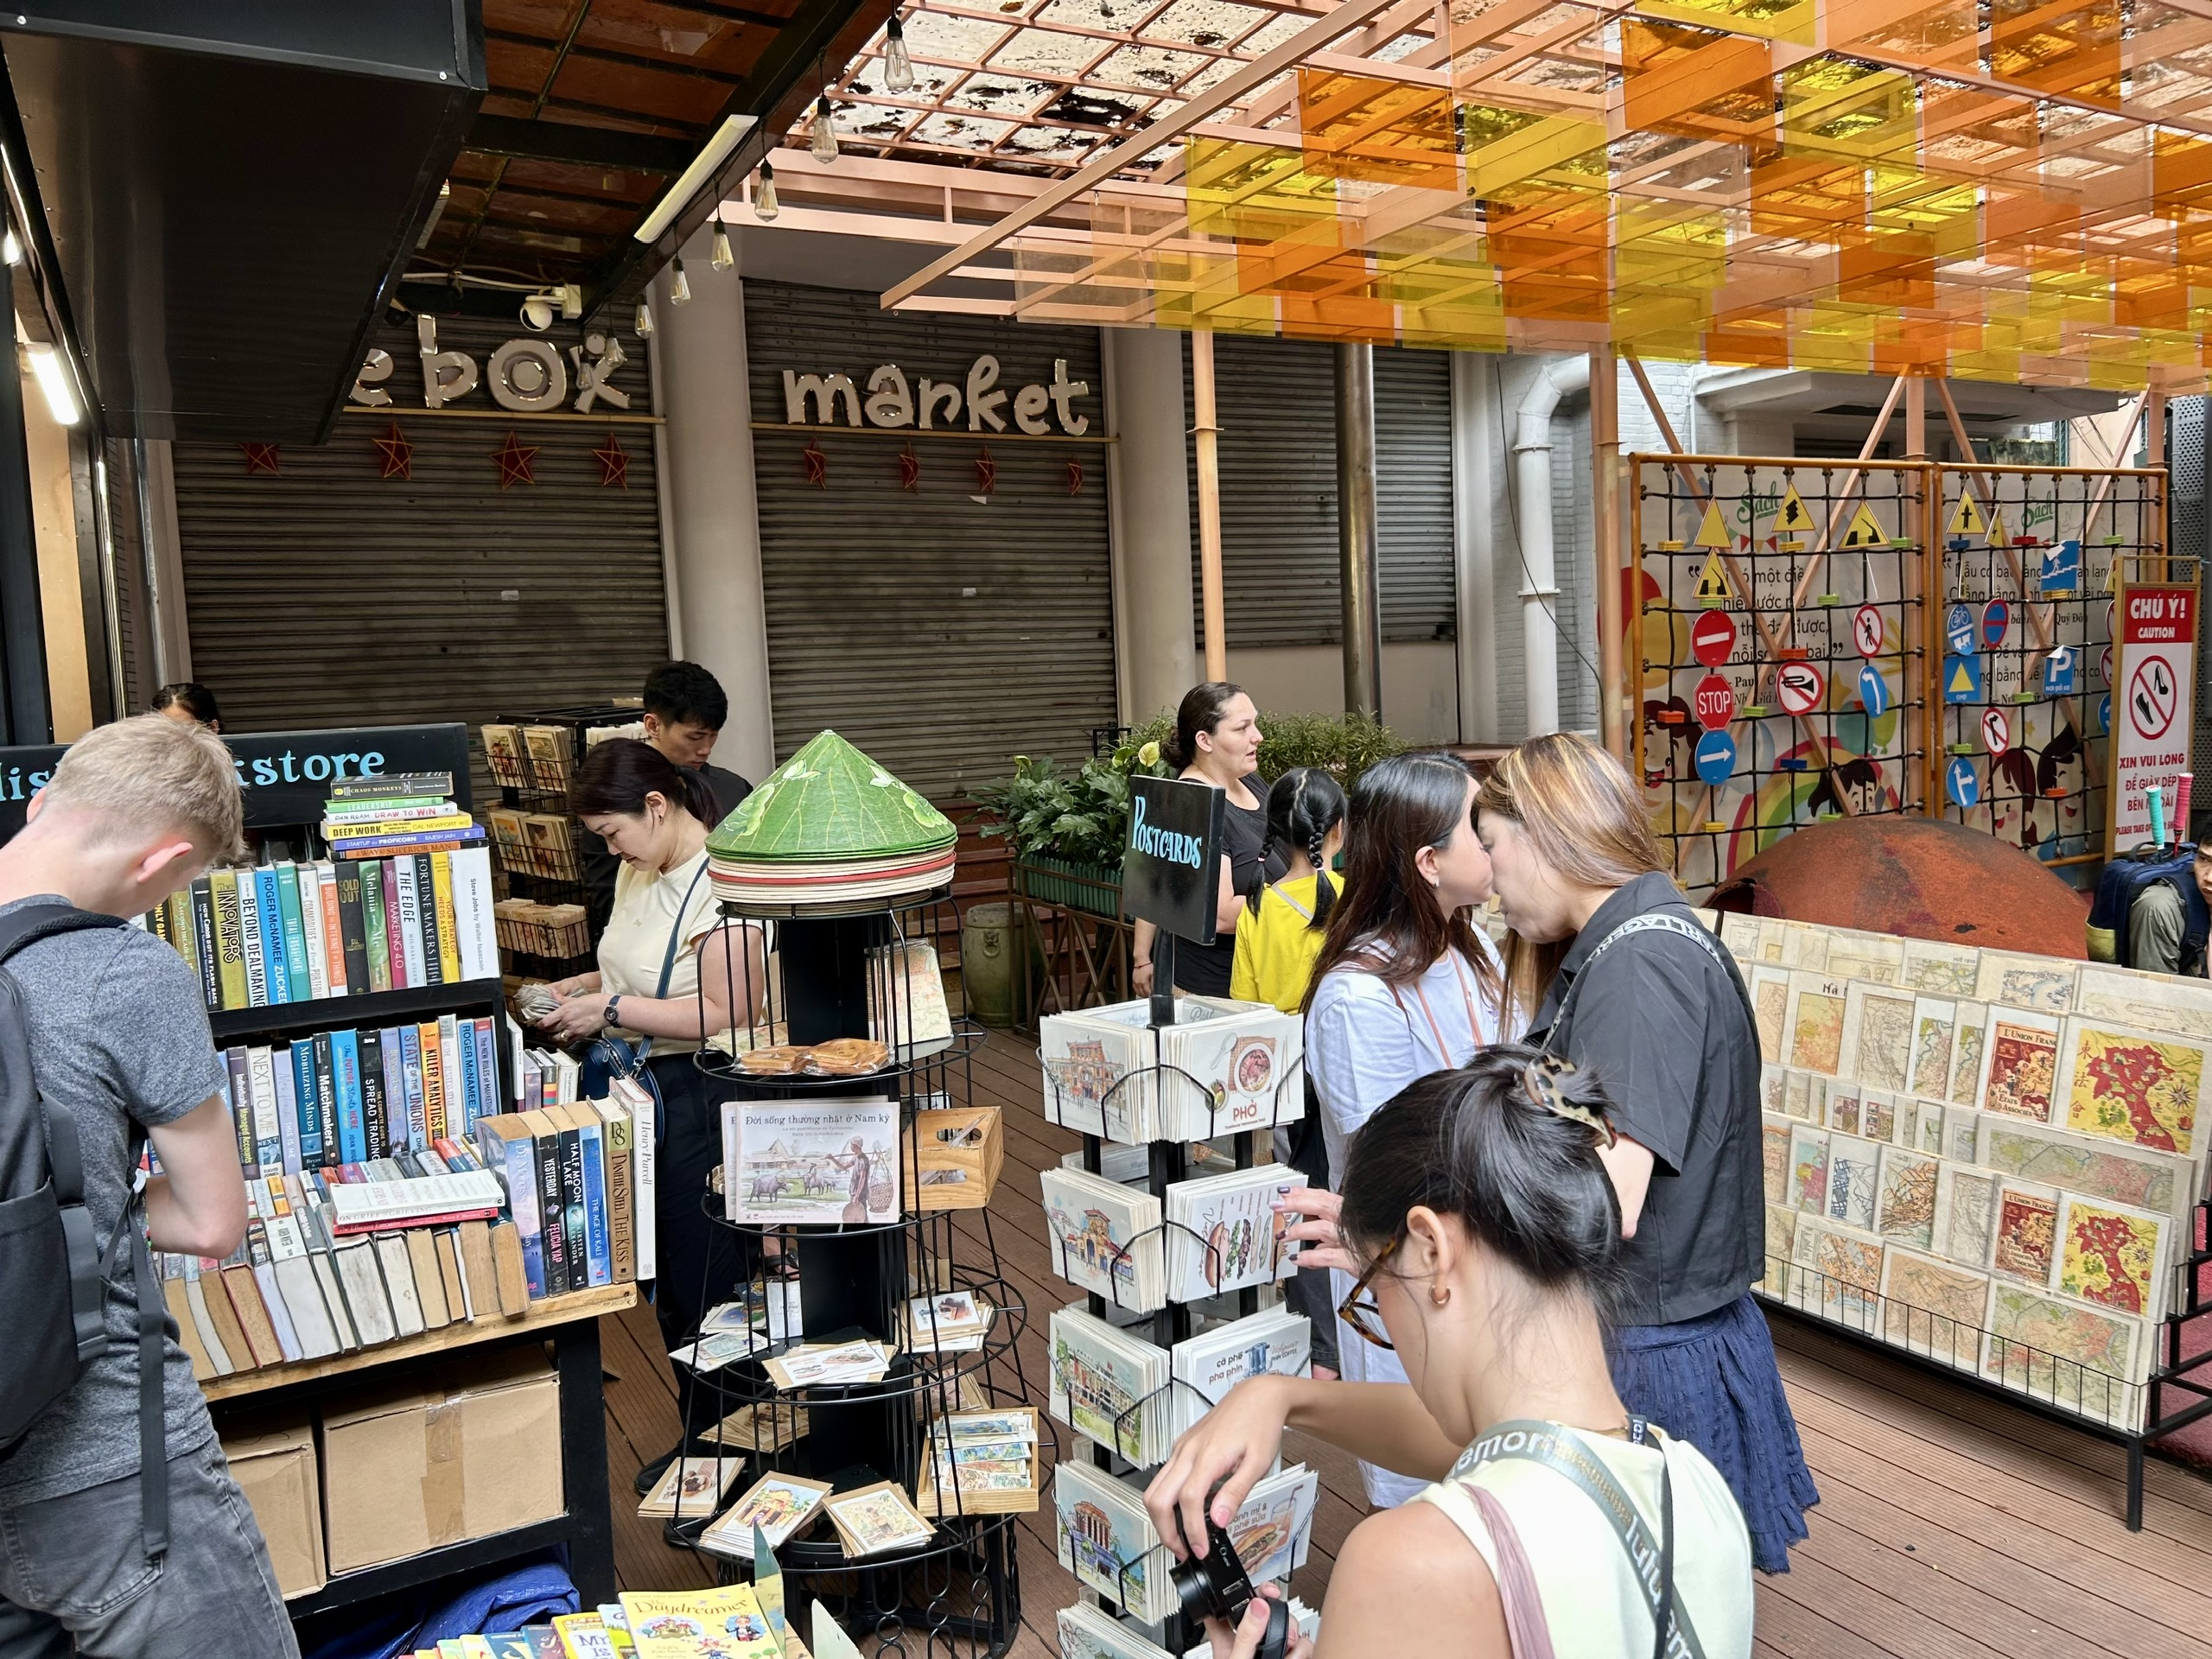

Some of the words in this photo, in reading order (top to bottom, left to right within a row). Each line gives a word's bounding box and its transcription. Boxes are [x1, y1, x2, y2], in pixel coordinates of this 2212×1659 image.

[782, 353, 1090, 436] market
[2130, 593, 2164, 619] CHÚ
[2168, 594, 2186, 619] Ý!
[2138, 626, 2176, 639] CAUTION
[1735, 676, 1757, 688] Pau
[1698, 690, 1731, 715] STOP
[2119, 756, 2137, 770] XIN
[2139, 754, 2157, 767] VUI
[2126, 772, 2138, 791] ĐỂ
[2162, 773, 2177, 787] DÉP
[347, 801, 392, 811] LEADERSHIP
[374, 810, 399, 819] DRAW
[2127, 796, 2143, 811] BÊN
[333, 827, 353, 837] DEEP
[355, 825, 382, 836] WORK
[427, 820, 457, 829] NEWPORT
[378, 836, 416, 845] PROFICORN
[1131, 795, 1202, 870] POSTCARDS
[387, 843, 428, 855] SUPERIOR
[431, 842, 452, 851] MAN
[264, 876, 277, 912] ROGER
[339, 879, 359, 892] SOLD
[399, 871, 412, 891] THE
[418, 858, 432, 908] FORTUNE
[325, 887, 336, 916] BUILDING
[340, 891, 359, 904] OUT
[366, 872, 378, 912] Melania
[372, 930, 383, 948] Me
[402, 896, 415, 923] EDGE
[446, 900, 454, 919] YOUR
[203, 918, 212, 939] Canon
[217, 889, 243, 963] INNOVATORS
[243, 898, 259, 940] BEYOND
[389, 901, 403, 950] MARKETING
[268, 913, 283, 963] McNAMEE
[329, 924, 340, 954] INTERNET
[423, 912, 436, 955] MAKERS
[441, 926, 449, 959] STRATEGY
[448, 920, 456, 954] STRATEGY
[476, 944, 485, 972] Isaacson
[248, 944, 265, 1007] DEALMAKING
[333, 961, 342, 983] THINGS
[404, 1034, 419, 1070] STATE
[462, 1025, 474, 1059] ROGER
[252, 1054, 270, 1087] NEXT
[300, 1046, 311, 1099] MOBILIZING
[345, 1058, 354, 1085] FUTURE
[425, 1048, 439, 1077] KILLER
[236, 1074, 247, 1107] Individually
[466, 1060, 477, 1106] McNAMEE
[257, 1089, 272, 1109] TO
[319, 1075, 334, 1147] Matchmakers
[365, 1078, 377, 1117] SPREAD
[428, 1080, 442, 1128] ANALYTICS
[484, 1084, 493, 1114] MARKETING
[1233, 1099, 1257, 1122] PHỞ
[239, 1108, 251, 1135] Managed
[258, 1113, 274, 1133] ME
[305, 1102, 315, 1132] MINDS
[349, 1109, 359, 1129] HERE
[409, 1092, 424, 1133] UNIONS
[746, 1114, 762, 1125] Đời
[765, 1115, 785, 1126] sống
[788, 1114, 821, 1125] thường
[823, 1114, 843, 1124] nhật
[855, 1114, 876, 1123] Nam
[243, 1136, 253, 1164] Accounts
[368, 1119, 381, 1160] TRADING
[639, 1121, 652, 1152] Henry
[288, 1147, 296, 1159] ME
[569, 1142, 580, 1167] HALF
[544, 1158, 557, 1197] YESTERDAY
[563, 1161, 572, 1186] LAKE
[612, 1154, 627, 1188] DANIELLE
[641, 1153, 652, 1185] Purcell
[515, 1144, 526, 1159] Di
[523, 1233, 534, 1249] Bay
[572, 1170, 582, 1203] MOON
[389, 1207, 432, 1217] GRIEVING
[613, 1188, 629, 1213] STEEL
[550, 1223, 561, 1249] FELICIA
[594, 1230, 601, 1238] OF
[615, 1215, 629, 1236] THE
[551, 1249, 563, 1263] YAP
[616, 1237, 629, 1262] KISS
[1228, 1351, 1243, 1366] phê
[1209, 1370, 1224, 1384] pha
[1226, 1363, 1243, 1379] phin
[633, 1599, 749, 1615] Daydreamer
